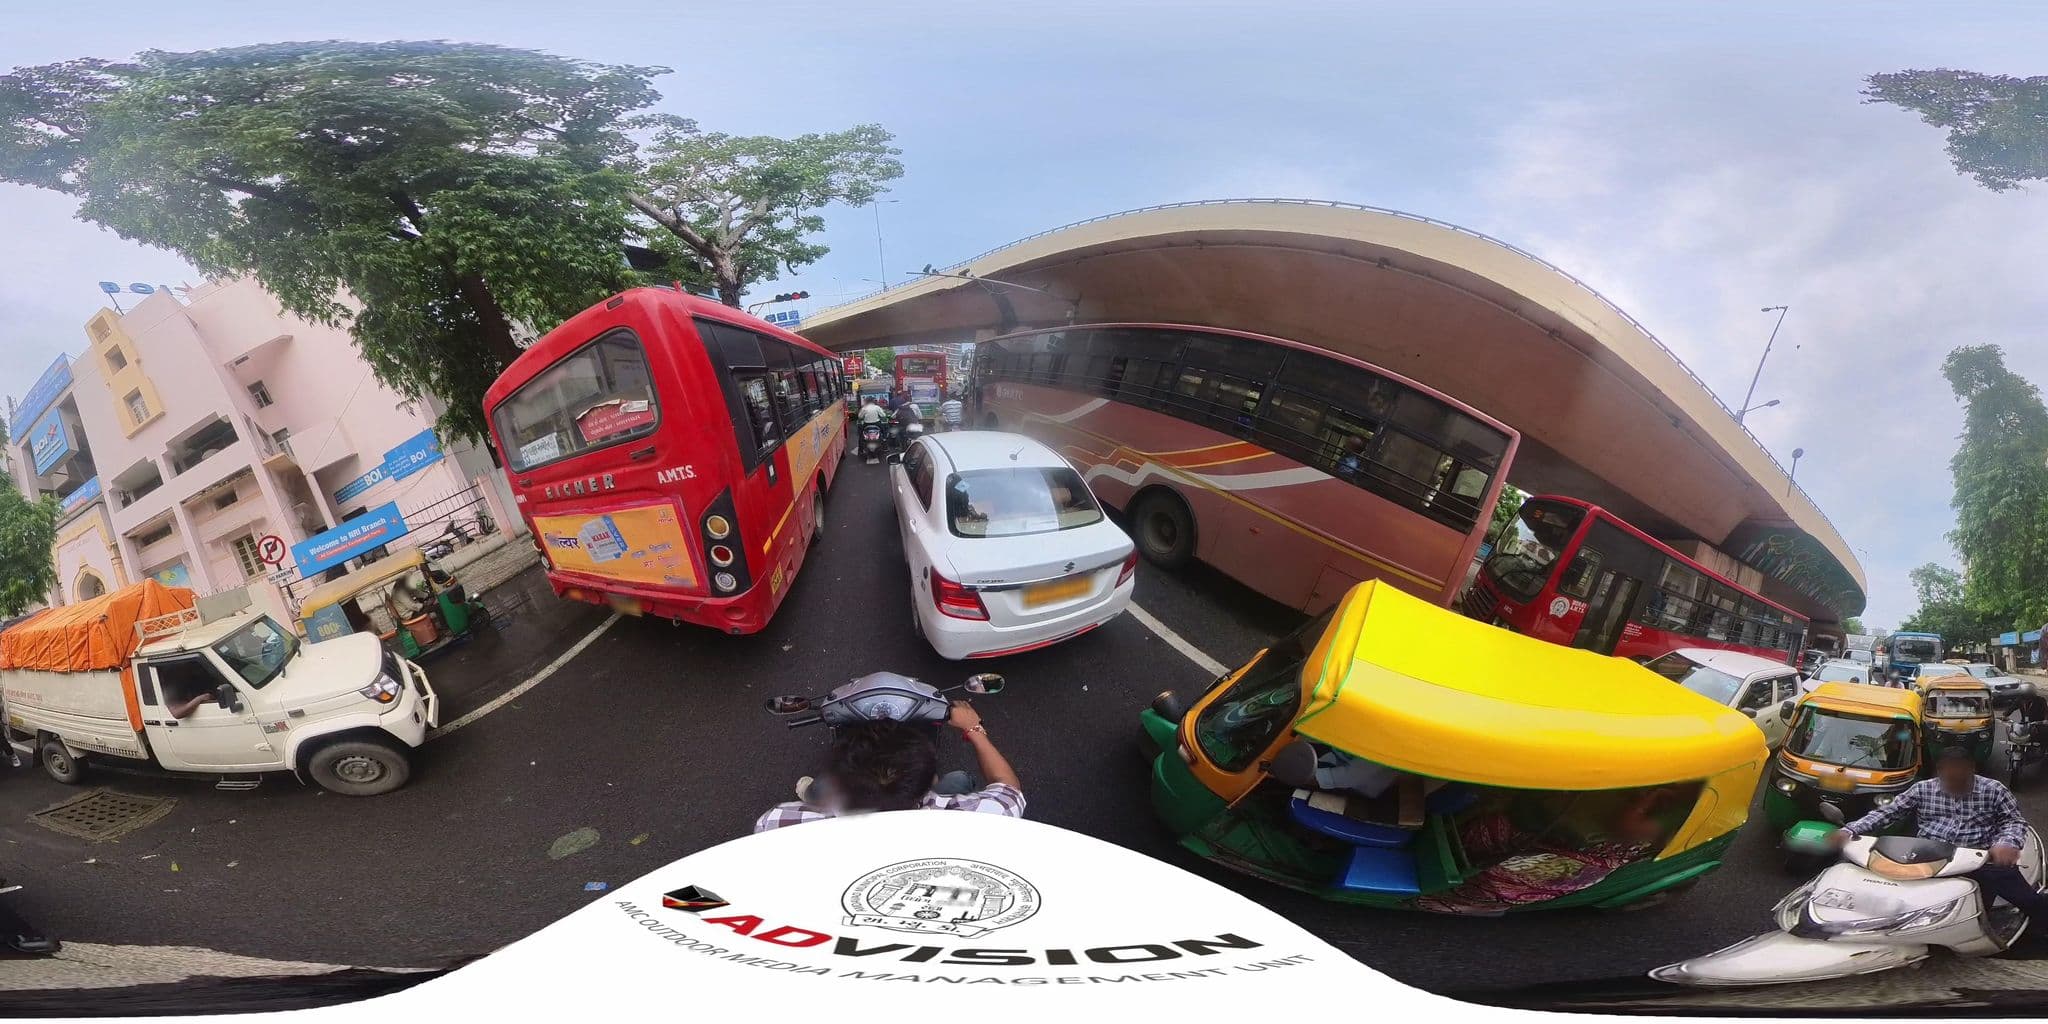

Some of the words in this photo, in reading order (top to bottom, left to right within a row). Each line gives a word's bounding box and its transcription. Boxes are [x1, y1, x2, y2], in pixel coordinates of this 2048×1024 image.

[410, 449, 427, 463] BOI
[363, 468, 383, 486] BOI
[657, 465, 697, 484] A.M.T.S.
[545, 473, 615, 499] EICHER
[309, 538, 339, 556] Welcome
[340, 535, 348, 543] to
[348, 530, 361, 540] NRI
[362, 518, 386, 532] Branch
[1862, 878, 1898, 886] HONDA
